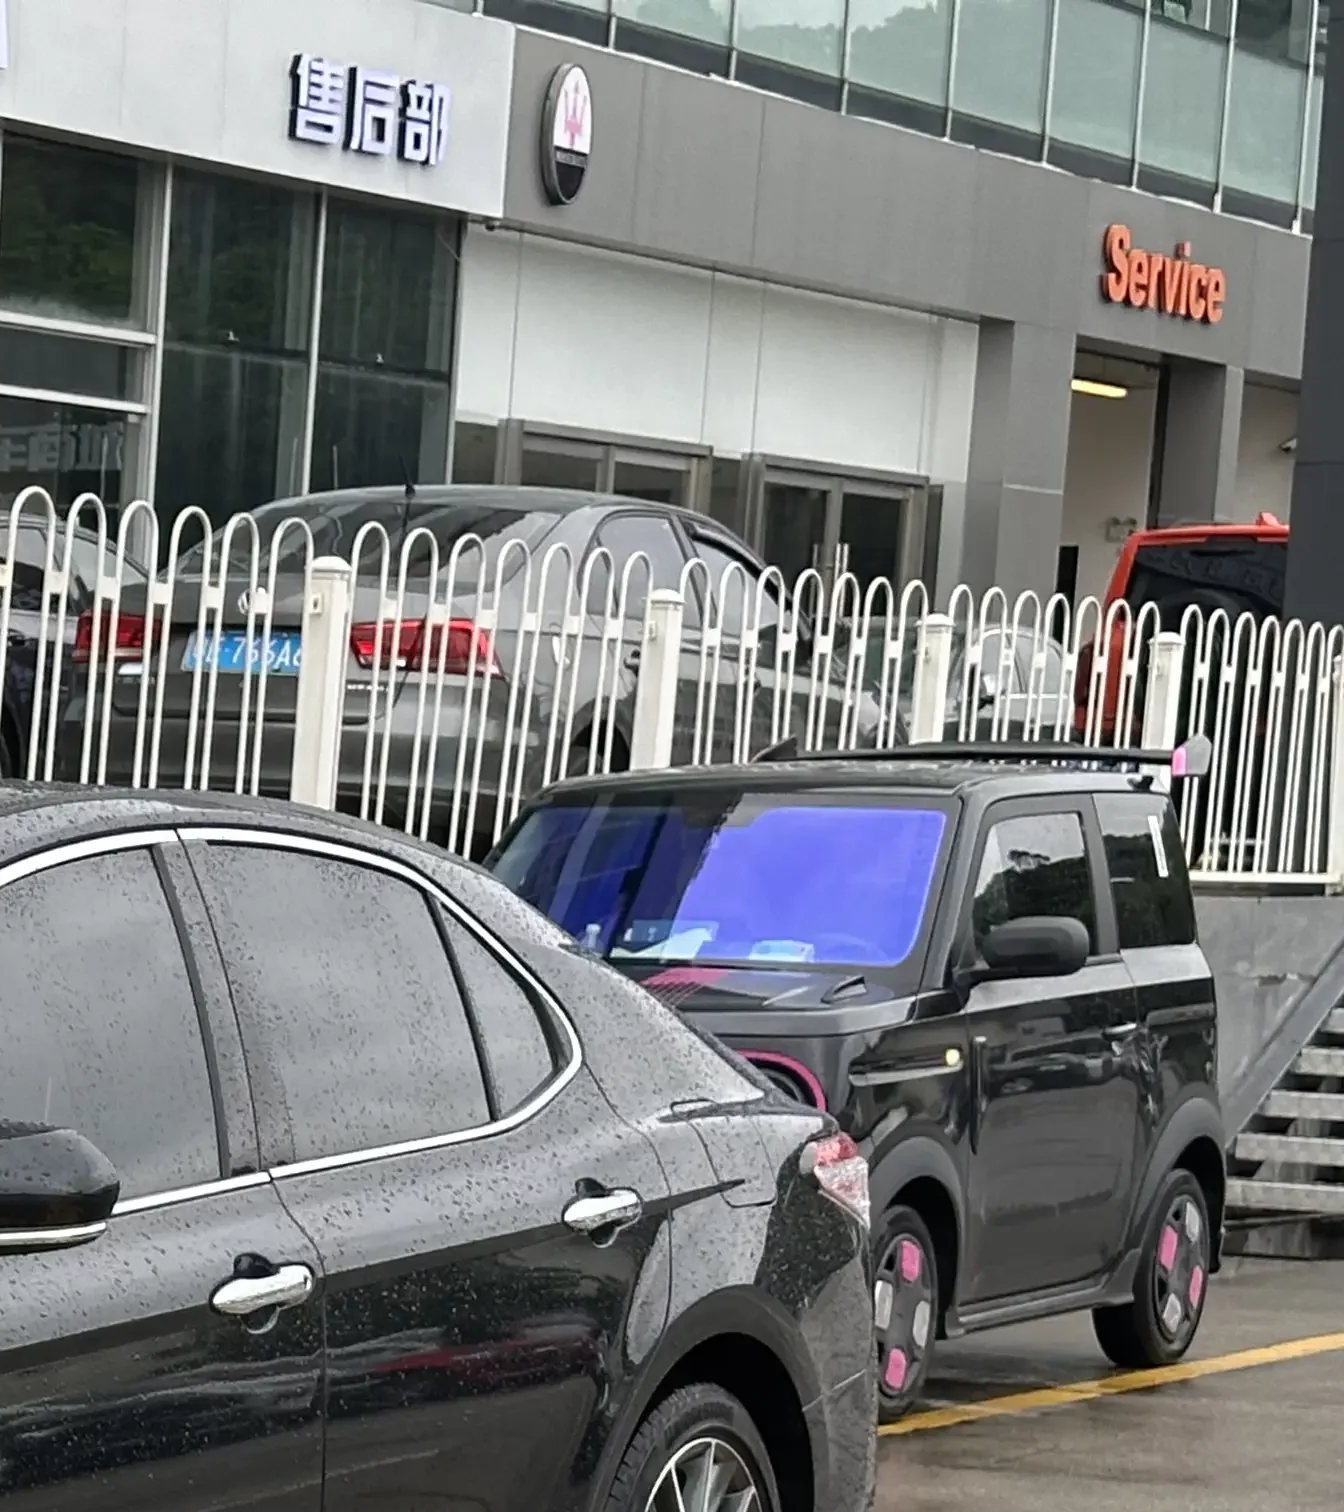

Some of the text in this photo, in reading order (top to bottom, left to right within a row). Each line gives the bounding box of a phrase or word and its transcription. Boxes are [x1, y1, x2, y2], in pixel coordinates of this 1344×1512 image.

[289, 54, 450, 165] 售后部
[1101, 224, 1228, 324] Service
